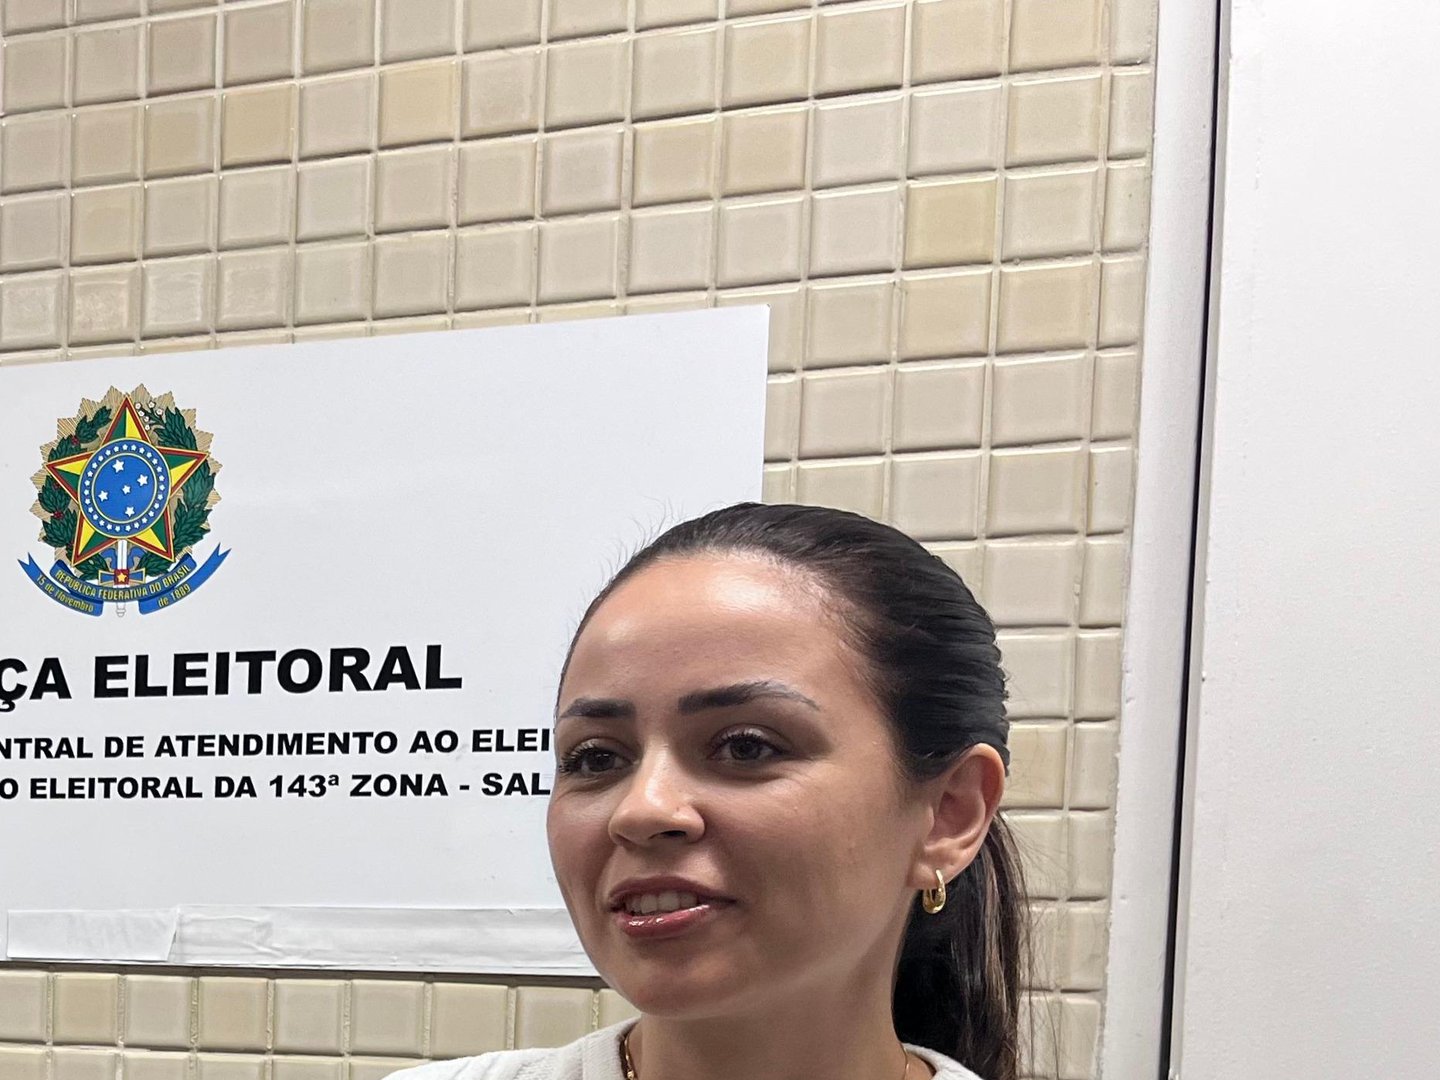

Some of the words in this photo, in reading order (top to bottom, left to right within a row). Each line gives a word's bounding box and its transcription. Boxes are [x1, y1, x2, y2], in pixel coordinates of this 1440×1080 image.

[36, 574, 46, 586] 15
[45, 583, 55, 594] de
[54, 590, 94, 613] Novembro
[158, 596, 169, 607] de
[170, 583, 191, 600] 1889
[98, 587, 148, 601] FEDERATIVA
[149, 582, 162, 594] DO
[162, 564, 192, 588] BRASIL
[93, 644, 463, 699] ELEITORAL
[104, 735, 145, 758] DE
[154, 731, 398, 758] ATENDIMENTO
[409, 729, 459, 754] AO
[471, 728, 555, 753] ELEI
[30, 776, 203, 799] ELEITORAL
[214, 775, 257, 798] DA
[269, 774, 340, 798] 143ª
[349, 773, 449, 797] ZONA
